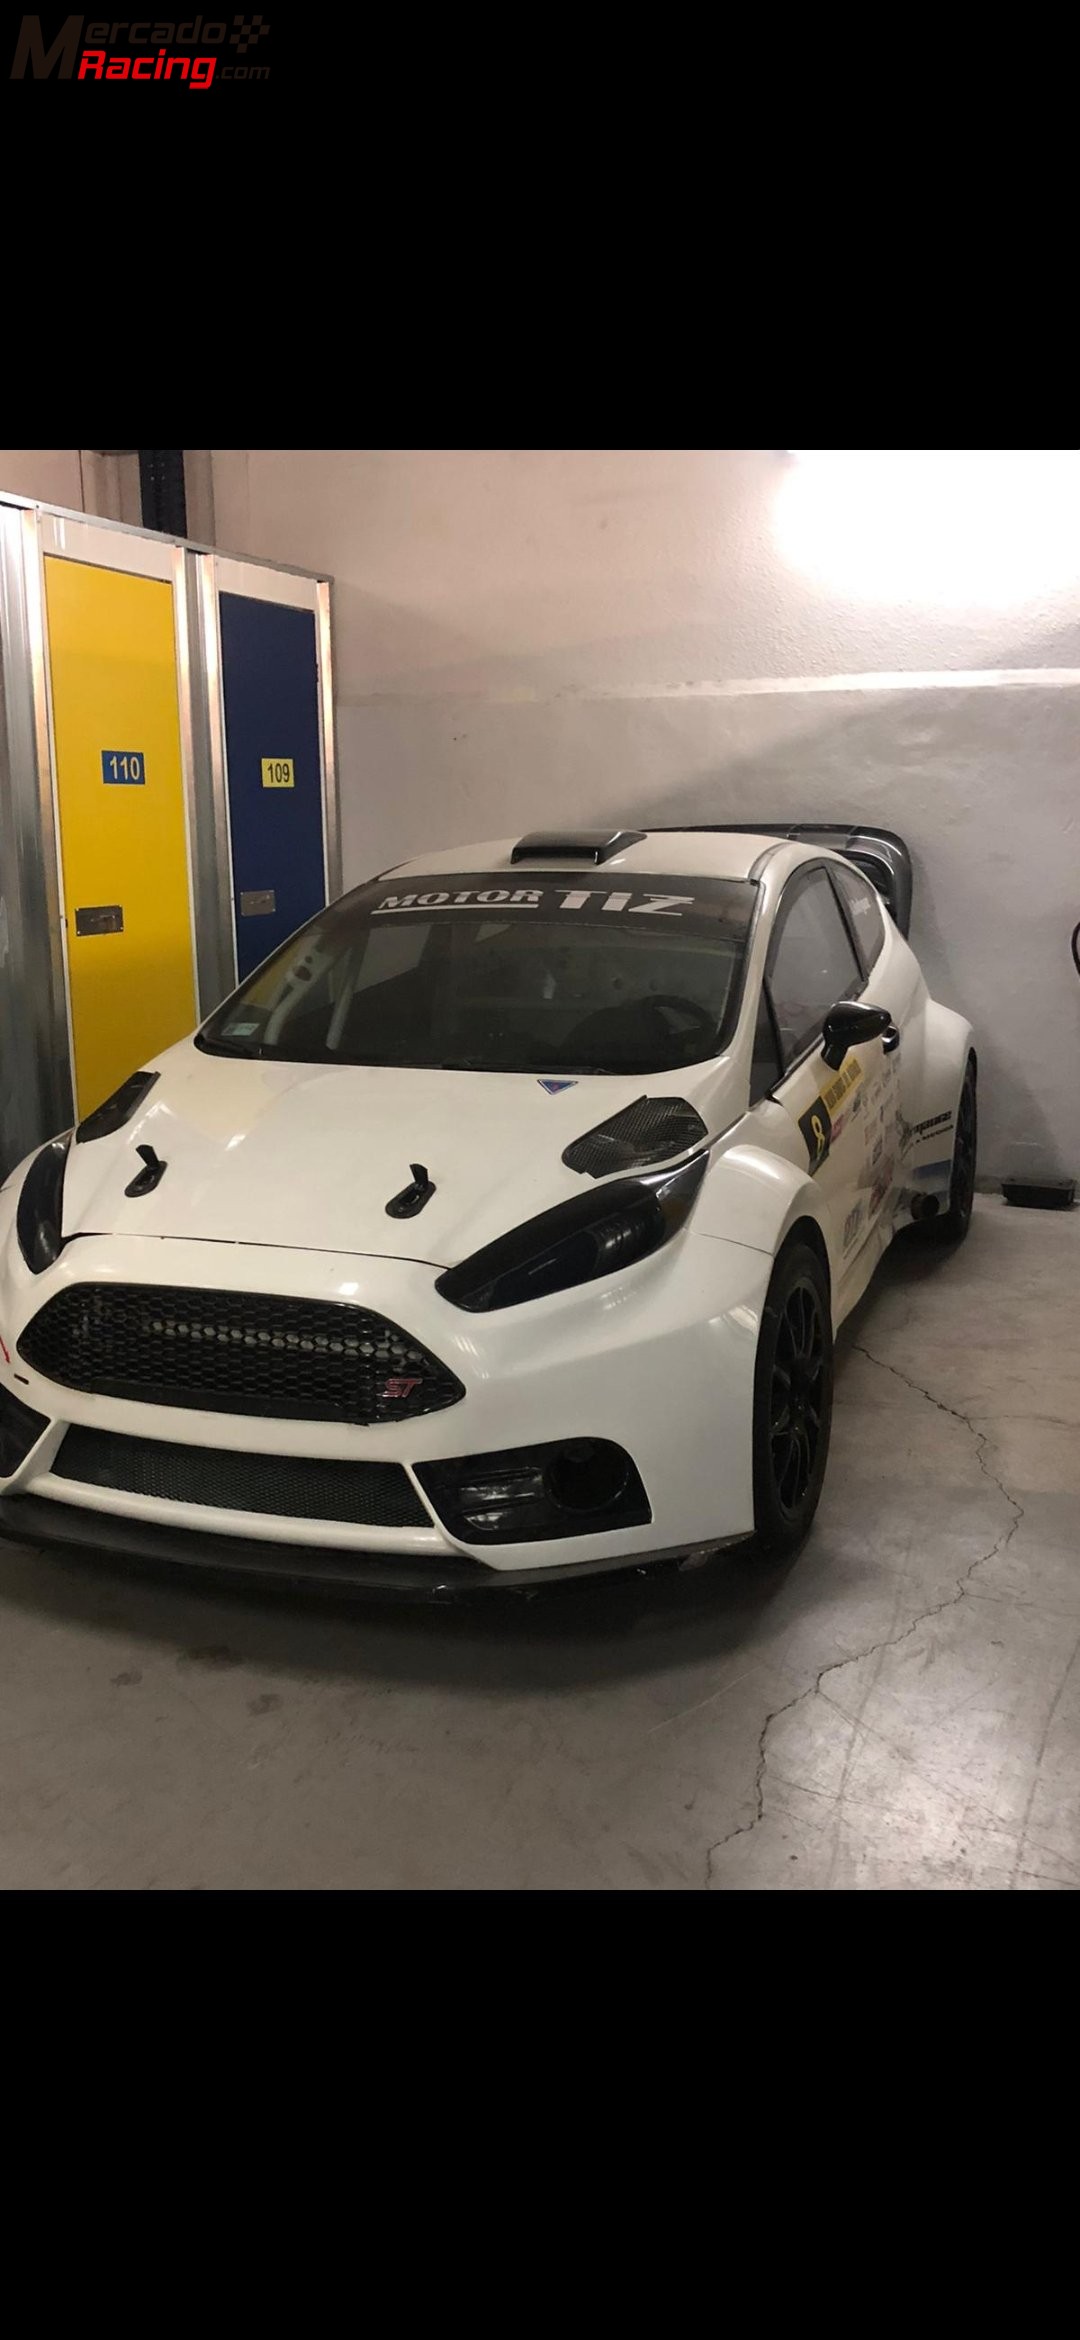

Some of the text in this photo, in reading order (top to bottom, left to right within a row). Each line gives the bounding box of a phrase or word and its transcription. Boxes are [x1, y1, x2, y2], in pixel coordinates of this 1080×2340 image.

[109, 755, 141, 781] 110
[267, 763, 290, 783] 109
[378, 889, 695, 916] MOTOR TIZ
[811, 1114, 825, 1162] 8
[382, 1378, 423, 1398] ST
